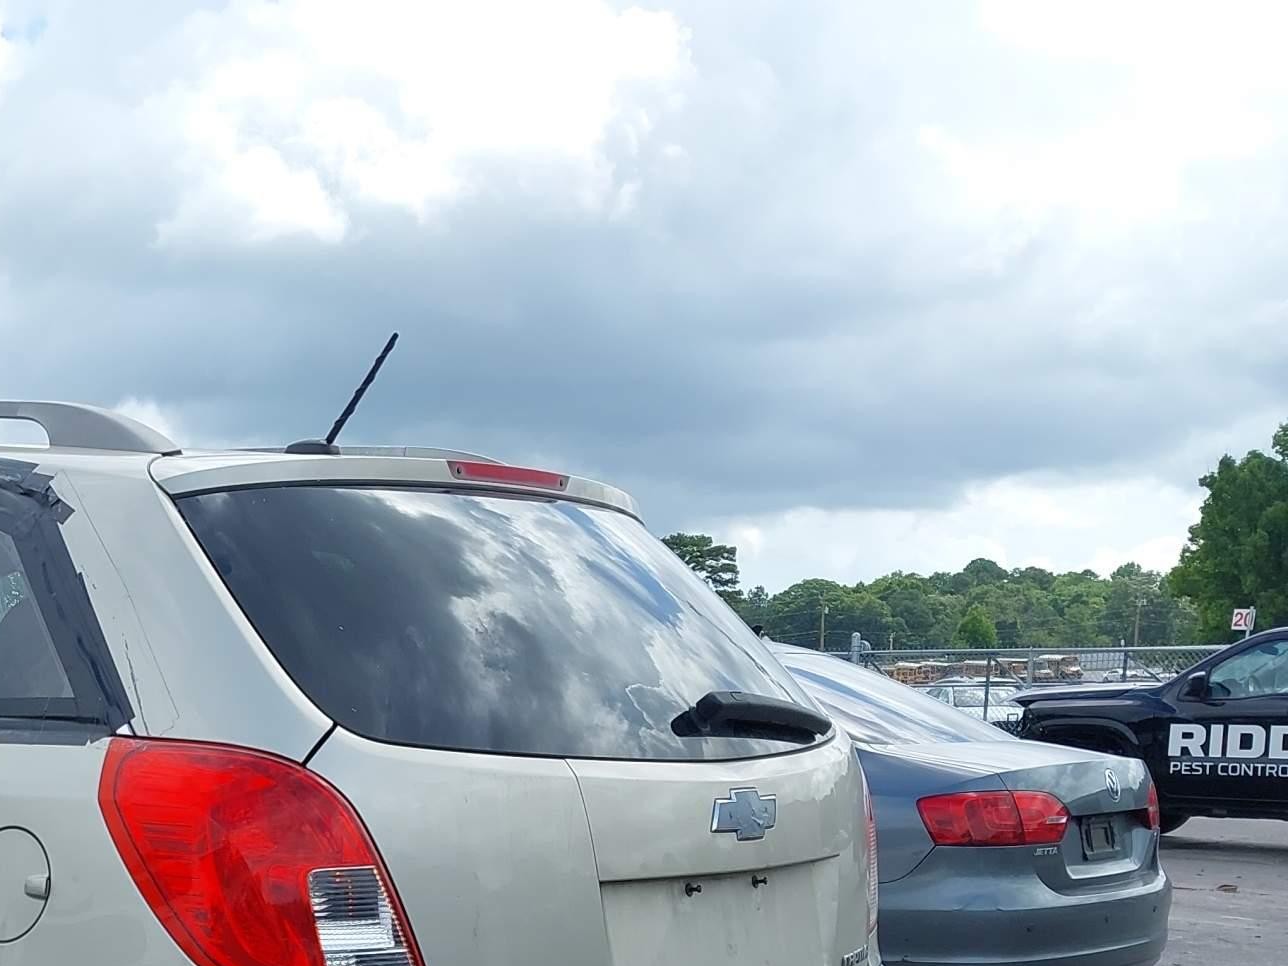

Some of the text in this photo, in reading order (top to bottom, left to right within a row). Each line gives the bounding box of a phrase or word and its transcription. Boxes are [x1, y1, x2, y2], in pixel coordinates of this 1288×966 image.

[1170, 762, 1288, 778] PEST CONTRO
[1032, 847, 1058, 856] JETTA
